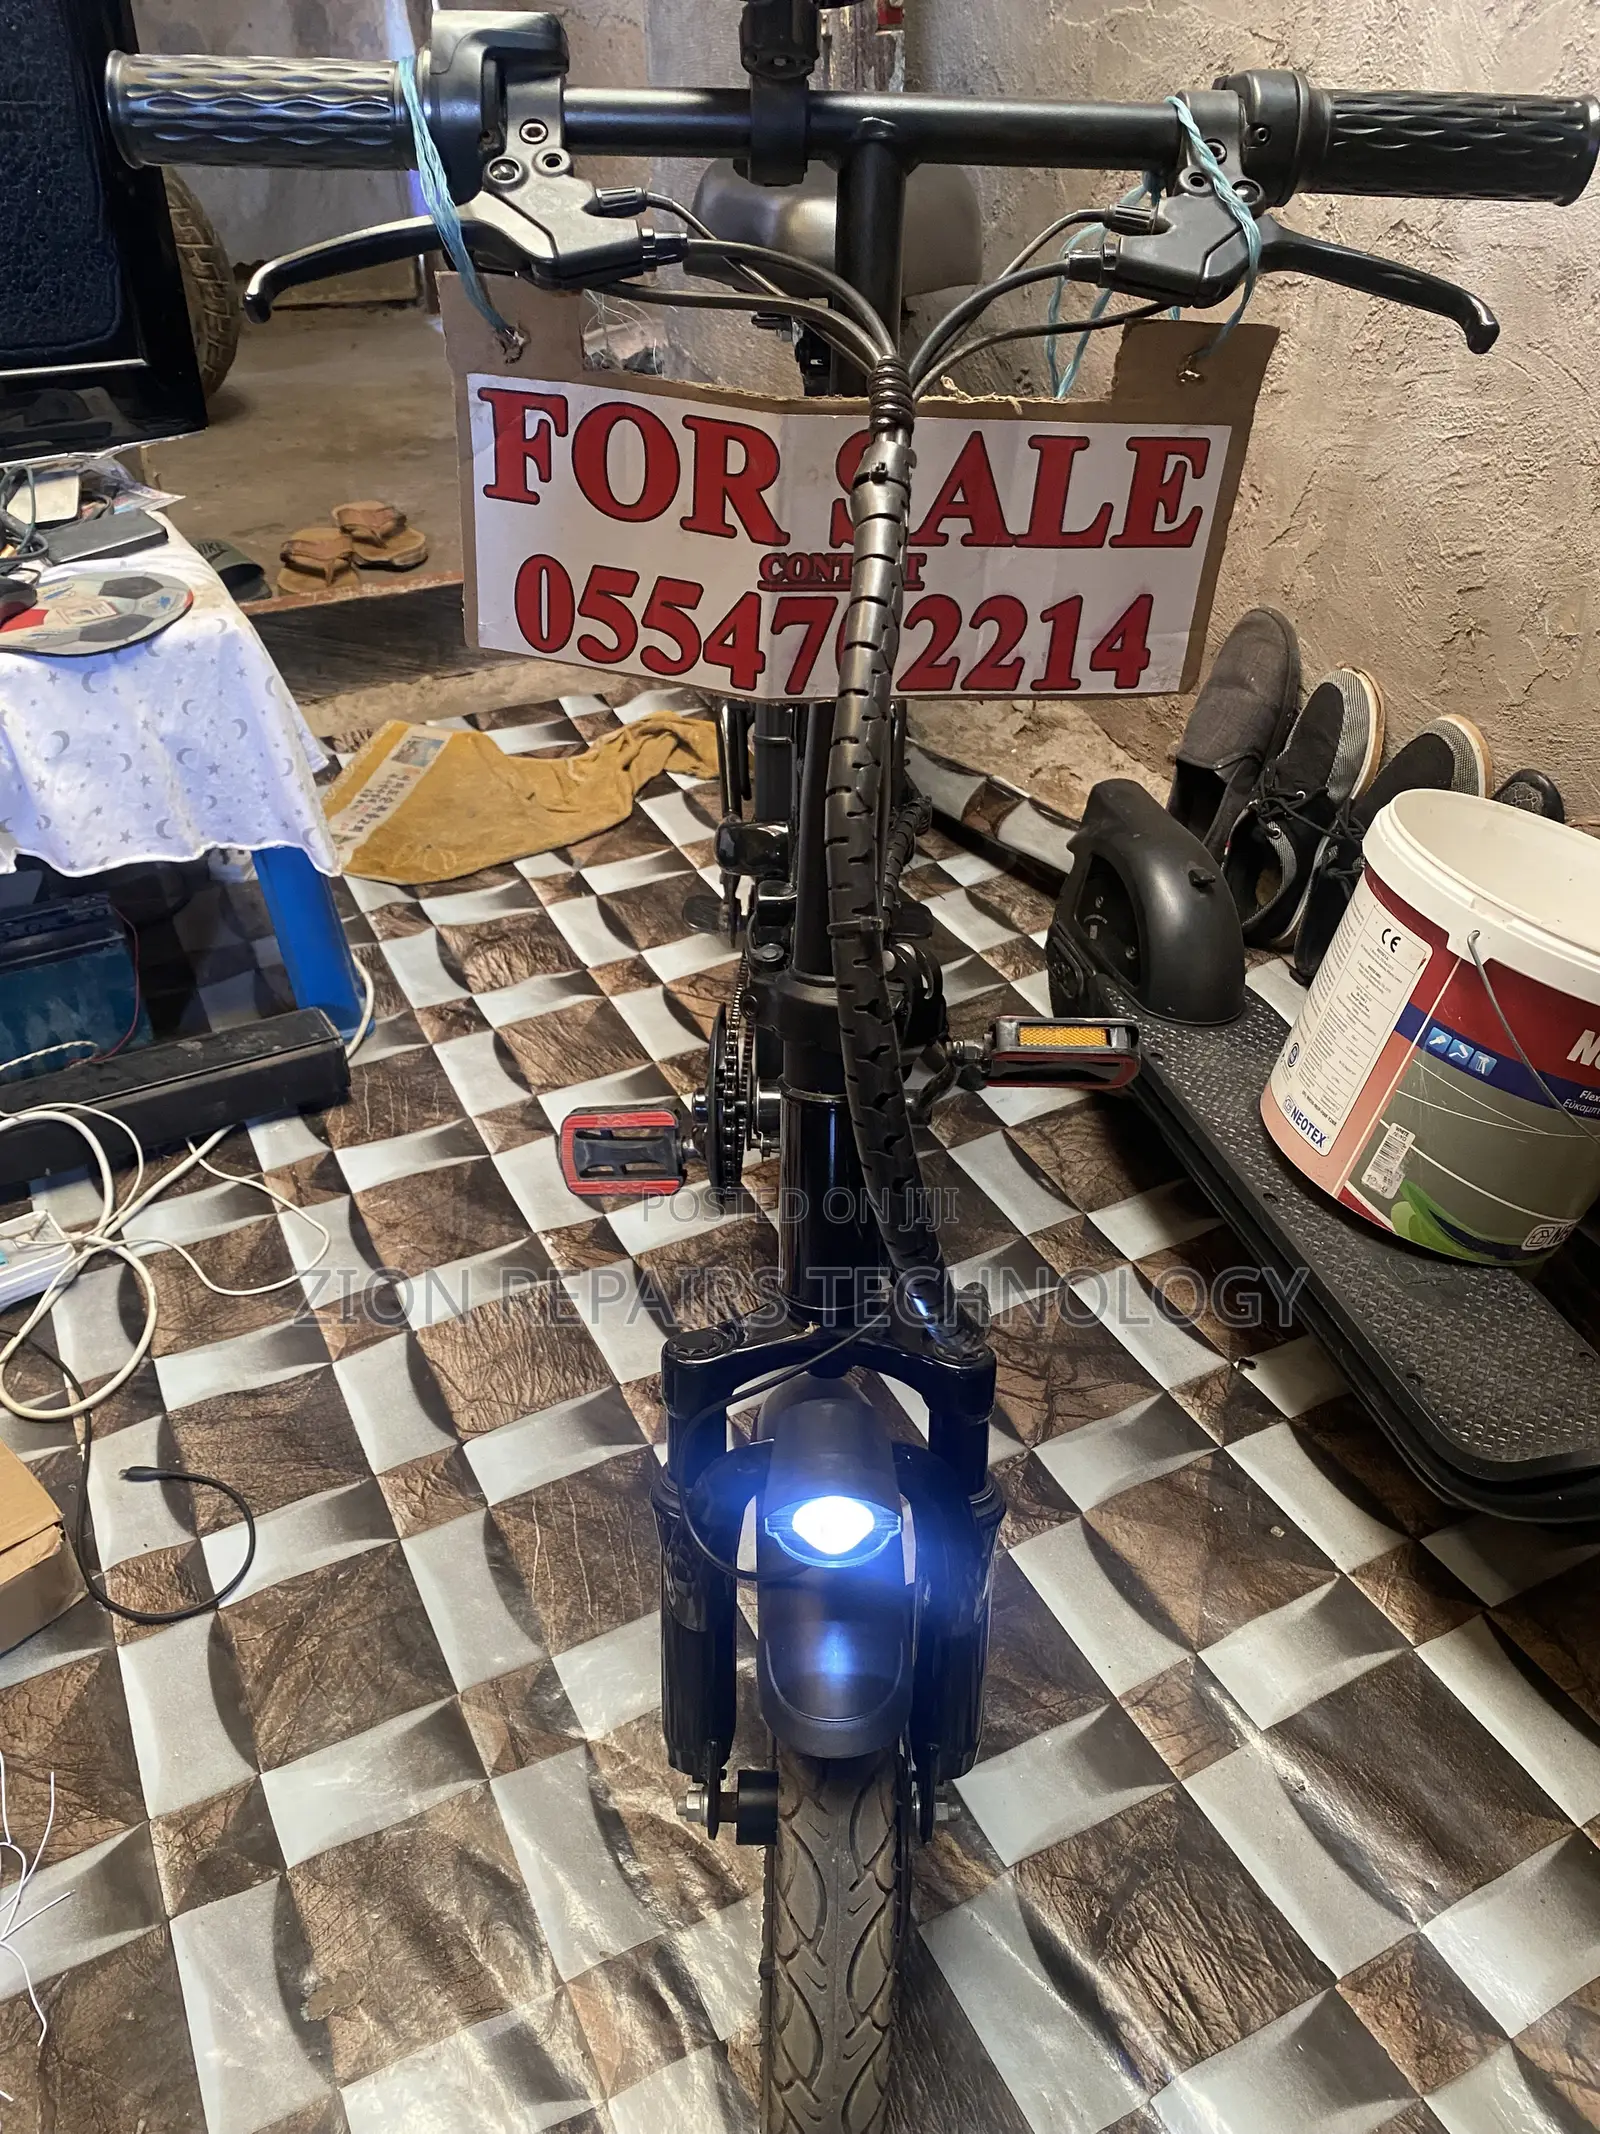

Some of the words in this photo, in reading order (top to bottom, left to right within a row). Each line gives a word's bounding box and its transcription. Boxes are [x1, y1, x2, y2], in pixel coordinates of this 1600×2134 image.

[477, 387, 791, 546] FOR
[759, 552, 927, 586] CONTT
[514, 553, 1154, 695] 055472214
[1566, 1028, 1600, 1071] N
[1579, 1089, 1600, 1103] Flex
[1290, 1106, 1328, 1149] NEOTEX
